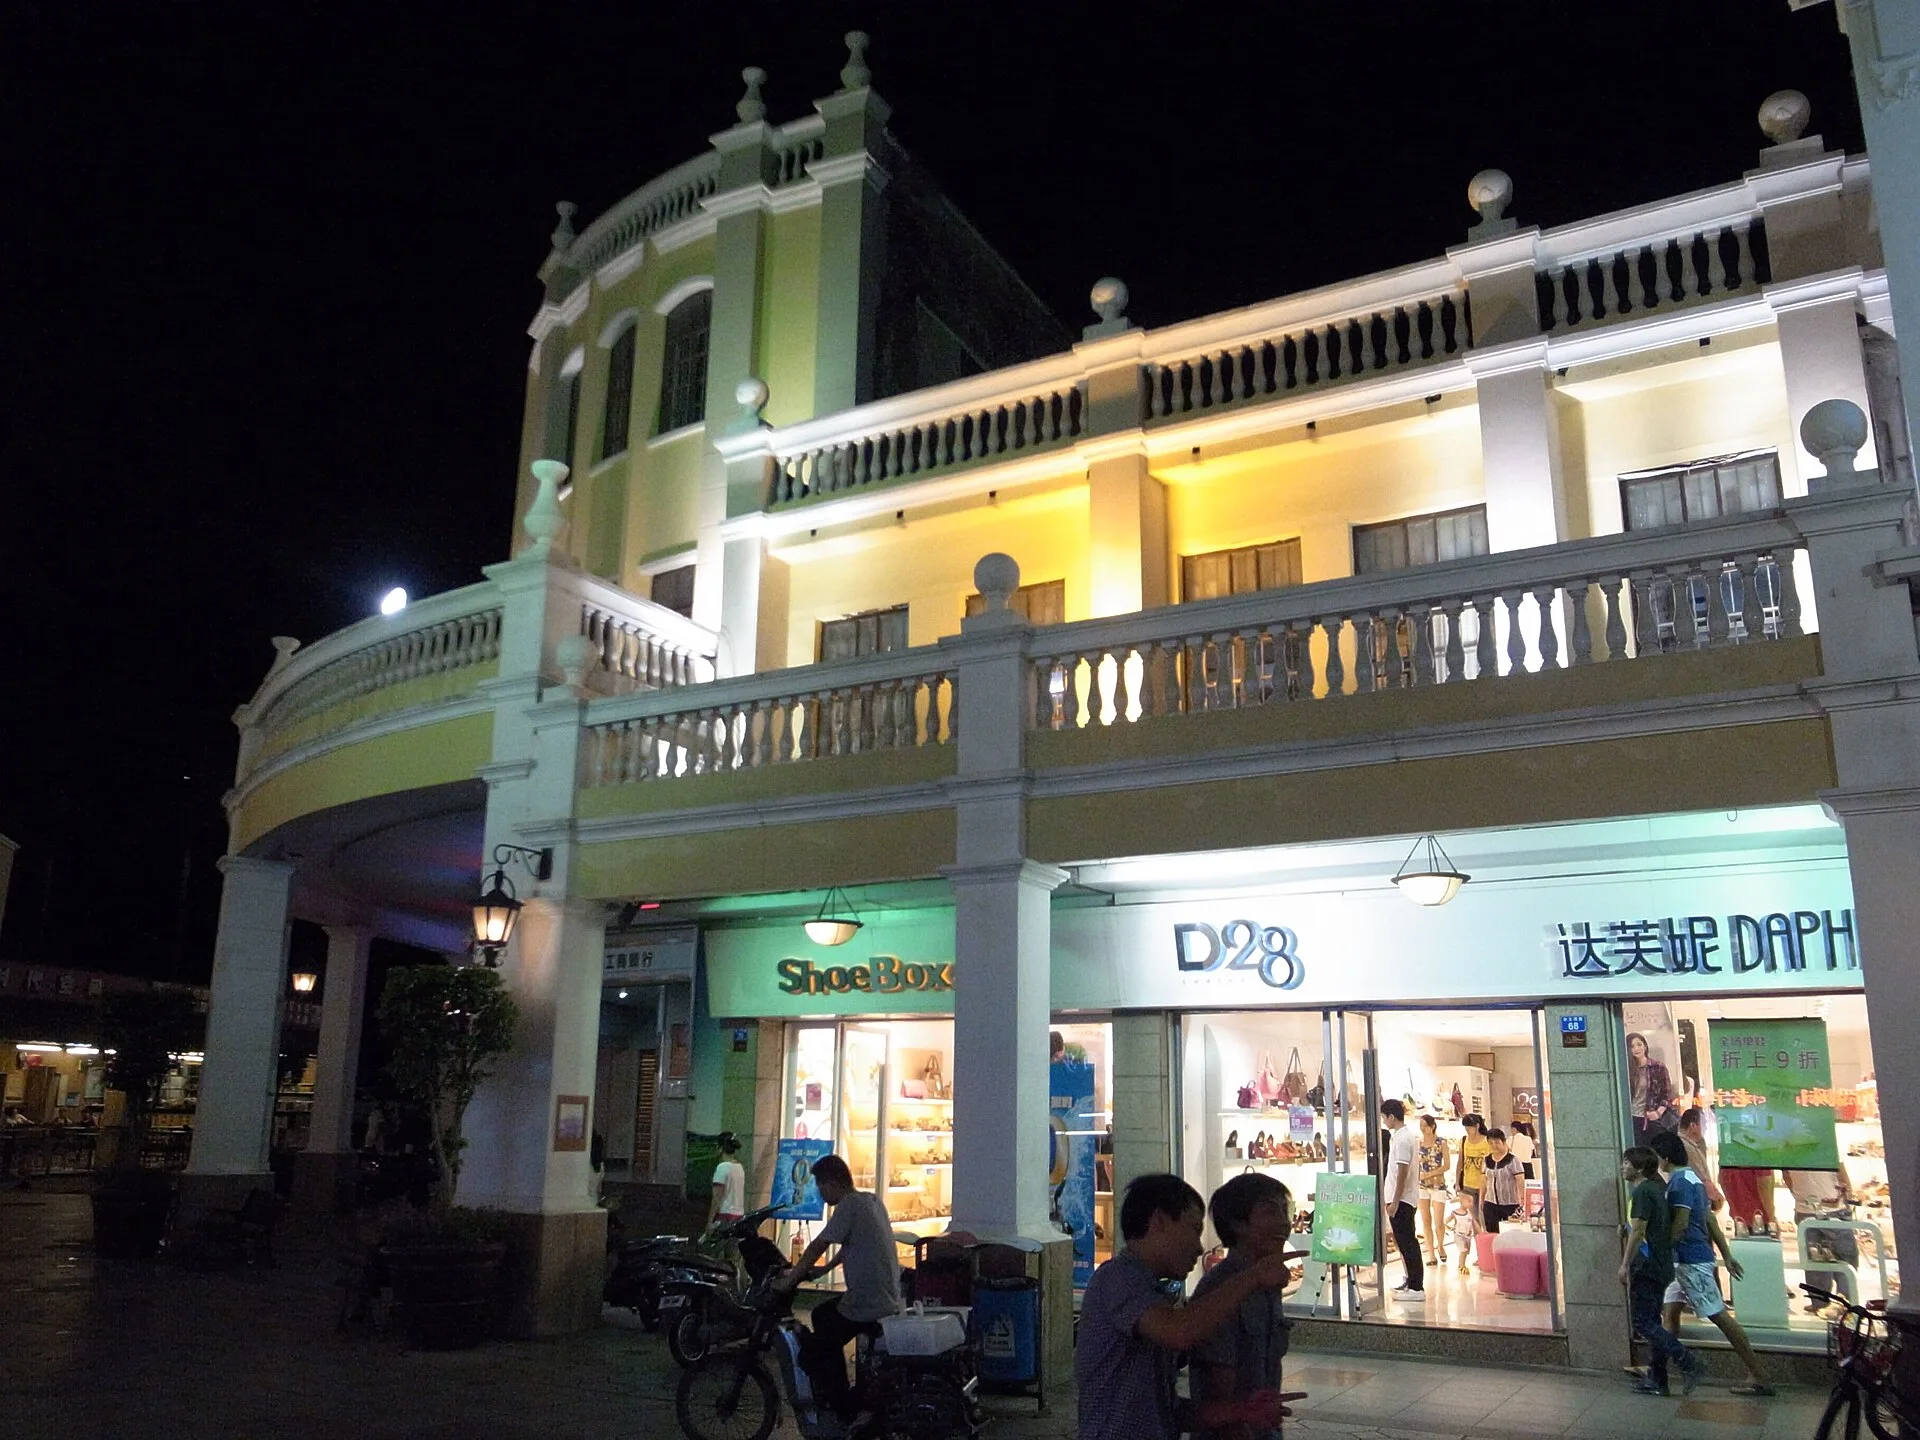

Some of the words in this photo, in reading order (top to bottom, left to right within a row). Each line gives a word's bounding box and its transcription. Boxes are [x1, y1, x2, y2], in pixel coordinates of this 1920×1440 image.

[1174, 919, 1306, 990] D28
[1556, 915, 1722, 977] 达芙妮
[1727, 908, 1861, 974] DAPH
[1567, 1022, 1579, 1030] 68
